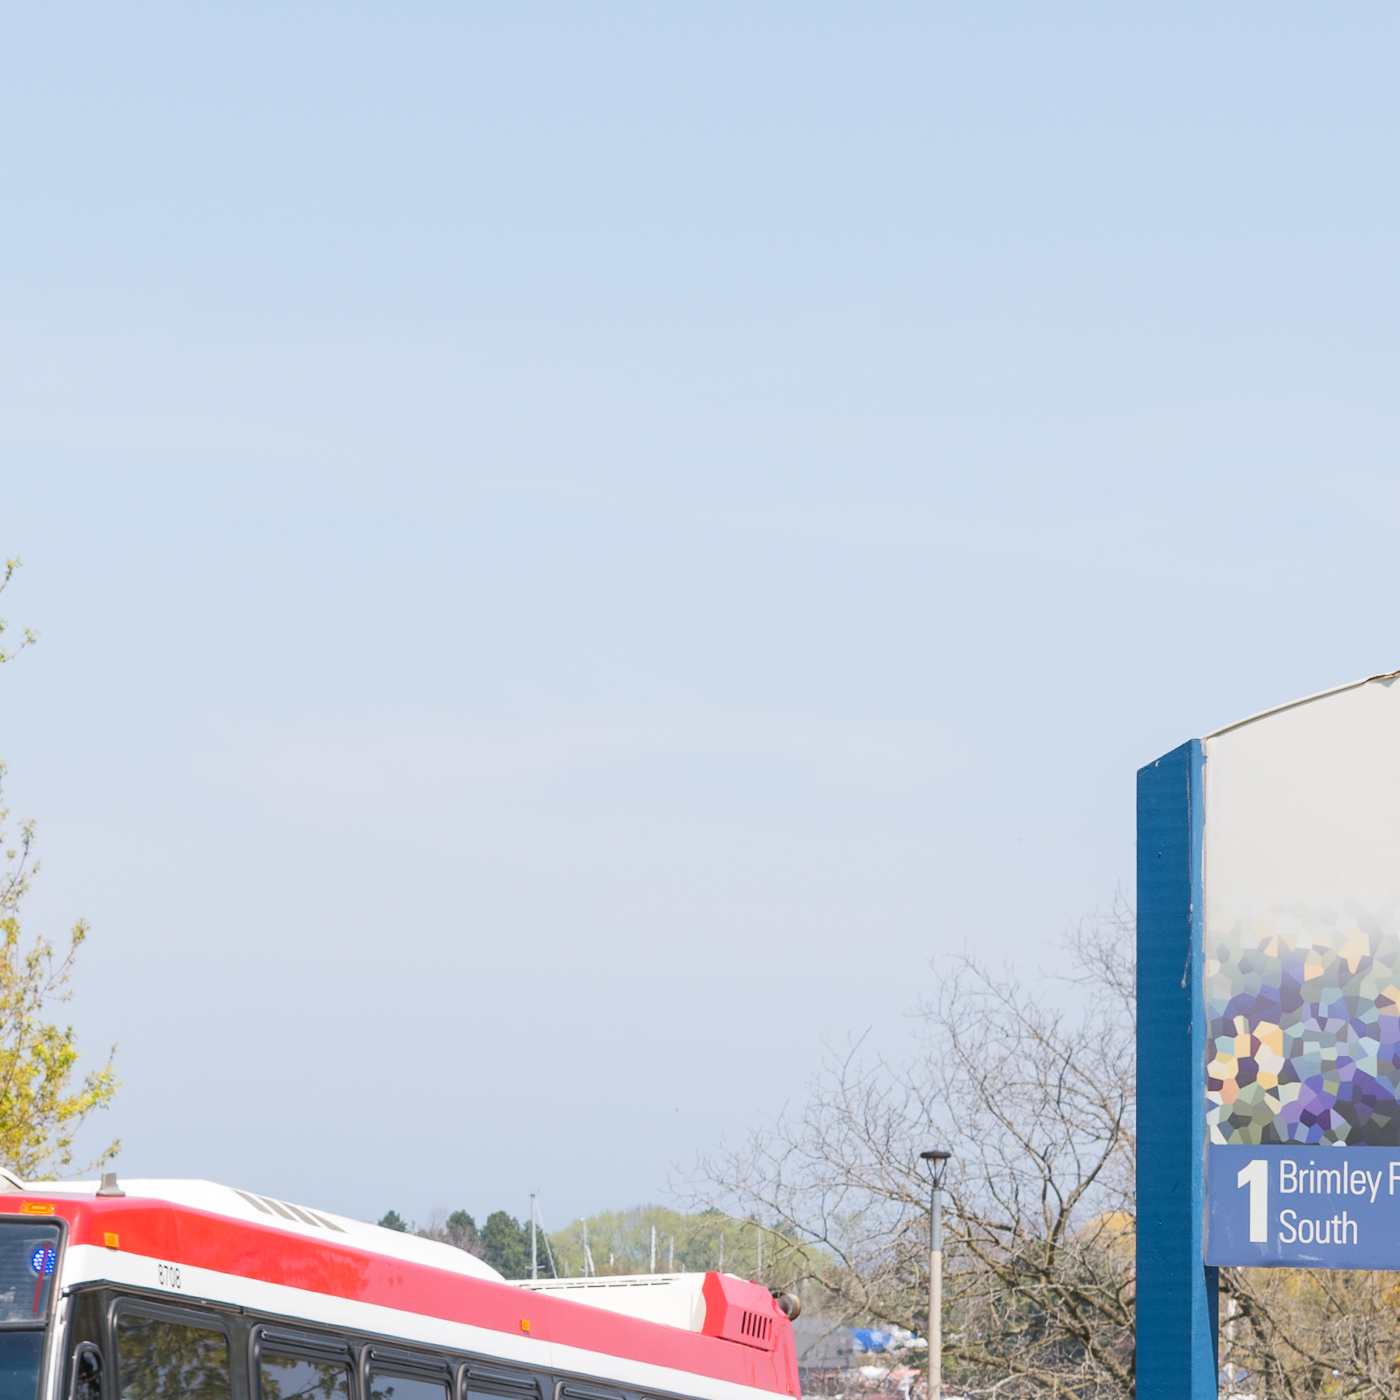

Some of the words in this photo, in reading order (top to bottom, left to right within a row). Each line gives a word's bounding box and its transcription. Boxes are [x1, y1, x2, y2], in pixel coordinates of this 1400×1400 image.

[1237, 1159, 1268, 1243] 1
[1279, 1159, 1383, 1203] Brimley
[1278, 1208, 1358, 1245] South
[158, 1263, 182, 1289] 8708
